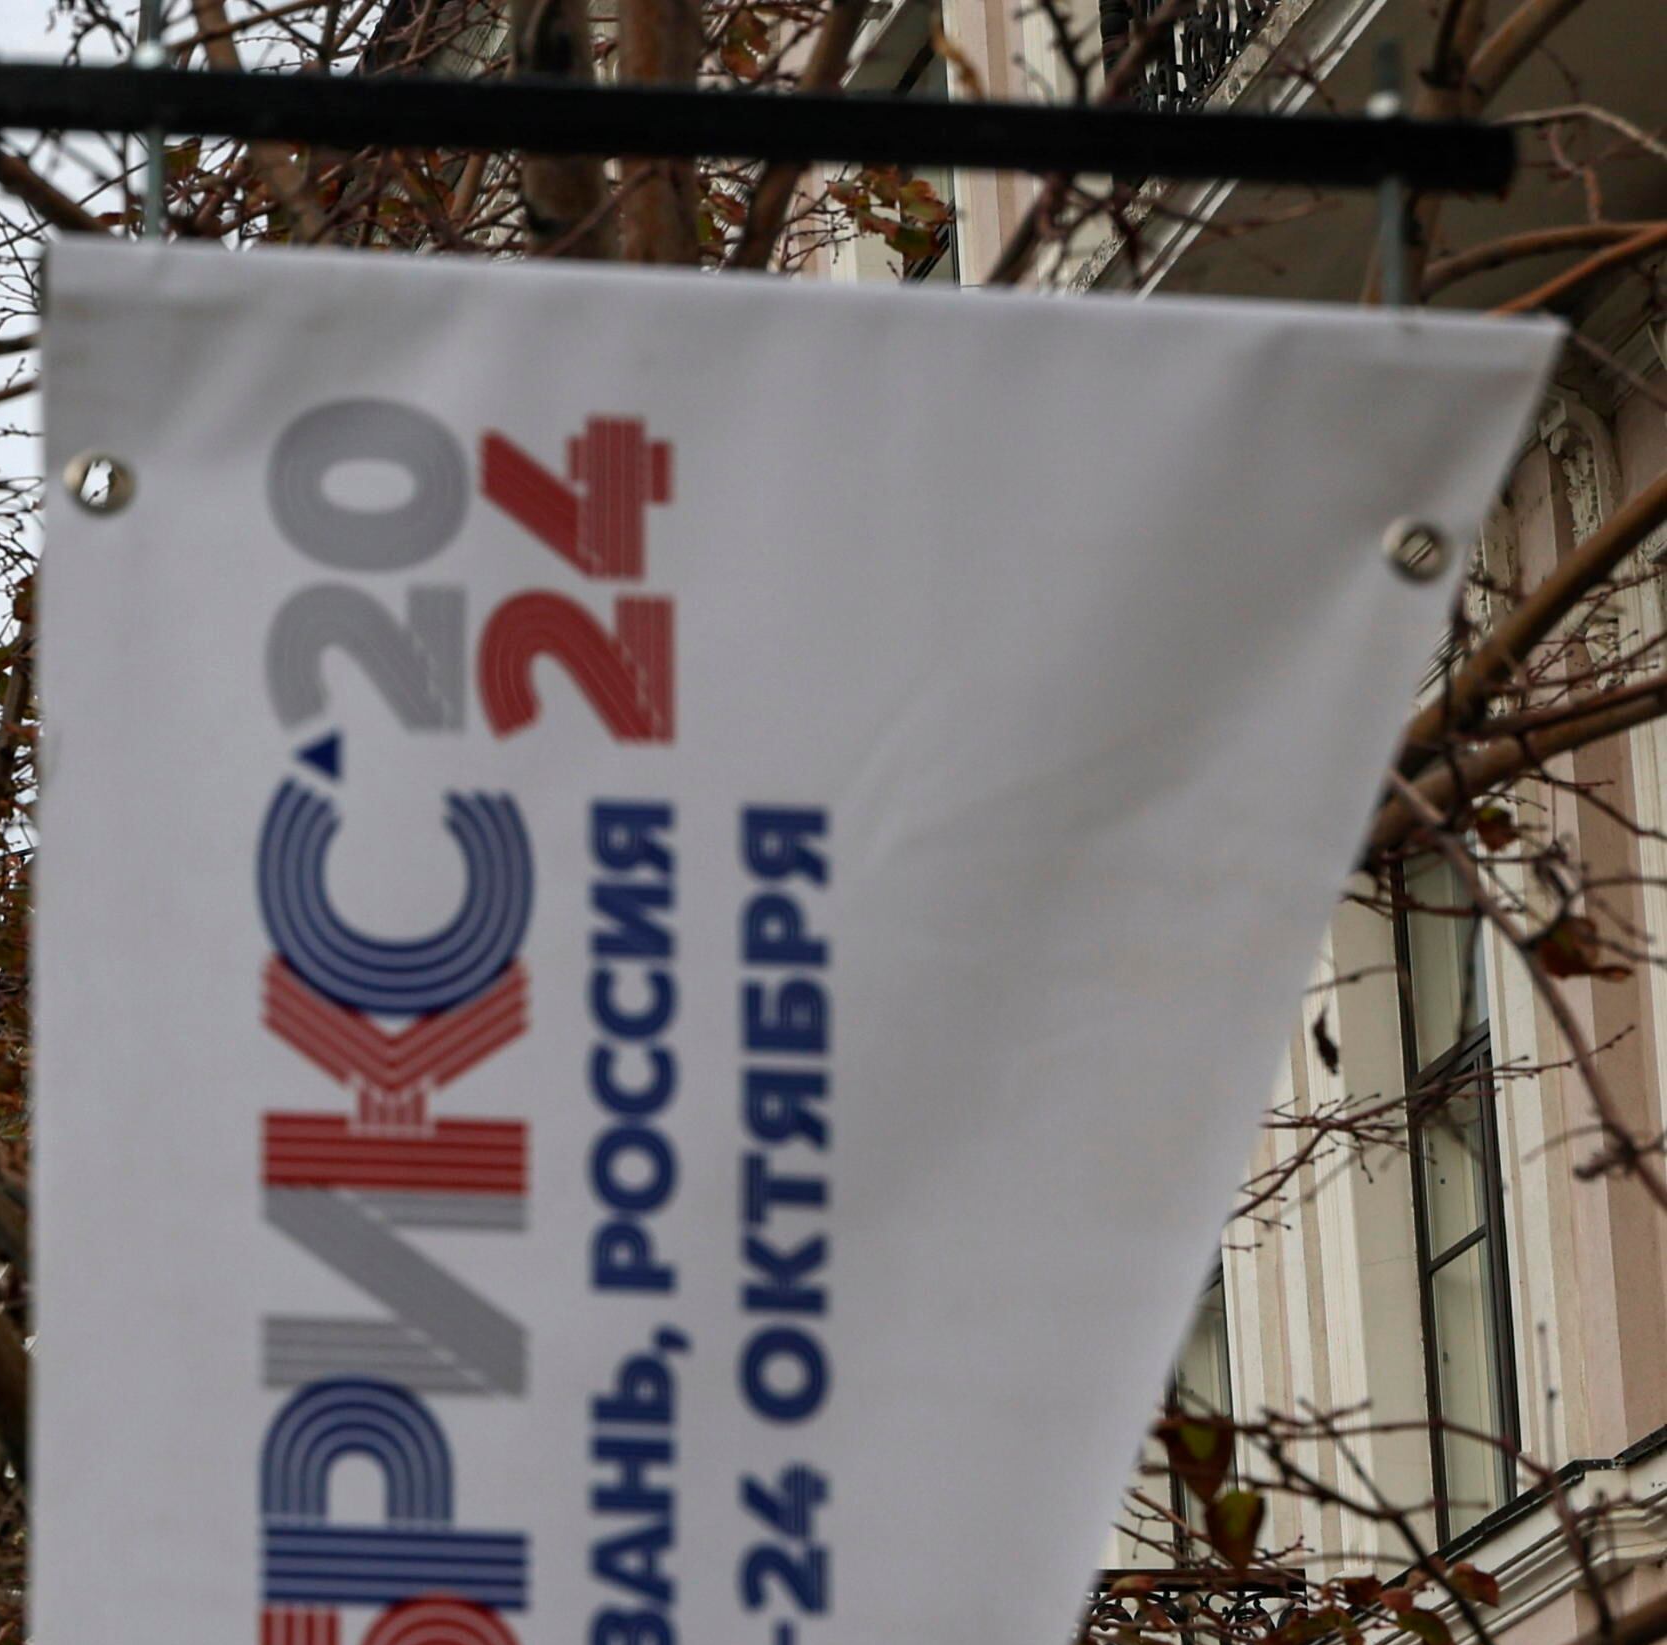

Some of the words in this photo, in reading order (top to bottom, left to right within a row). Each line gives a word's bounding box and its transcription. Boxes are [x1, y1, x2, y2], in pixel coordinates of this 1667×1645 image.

[265, 396, 468, 732] 20
[477, 414, 677, 746] 24
[589, 798, 677, 1294] РОССИЯ
[740, 806, 830, 1424] ОКТЯБРЯ
